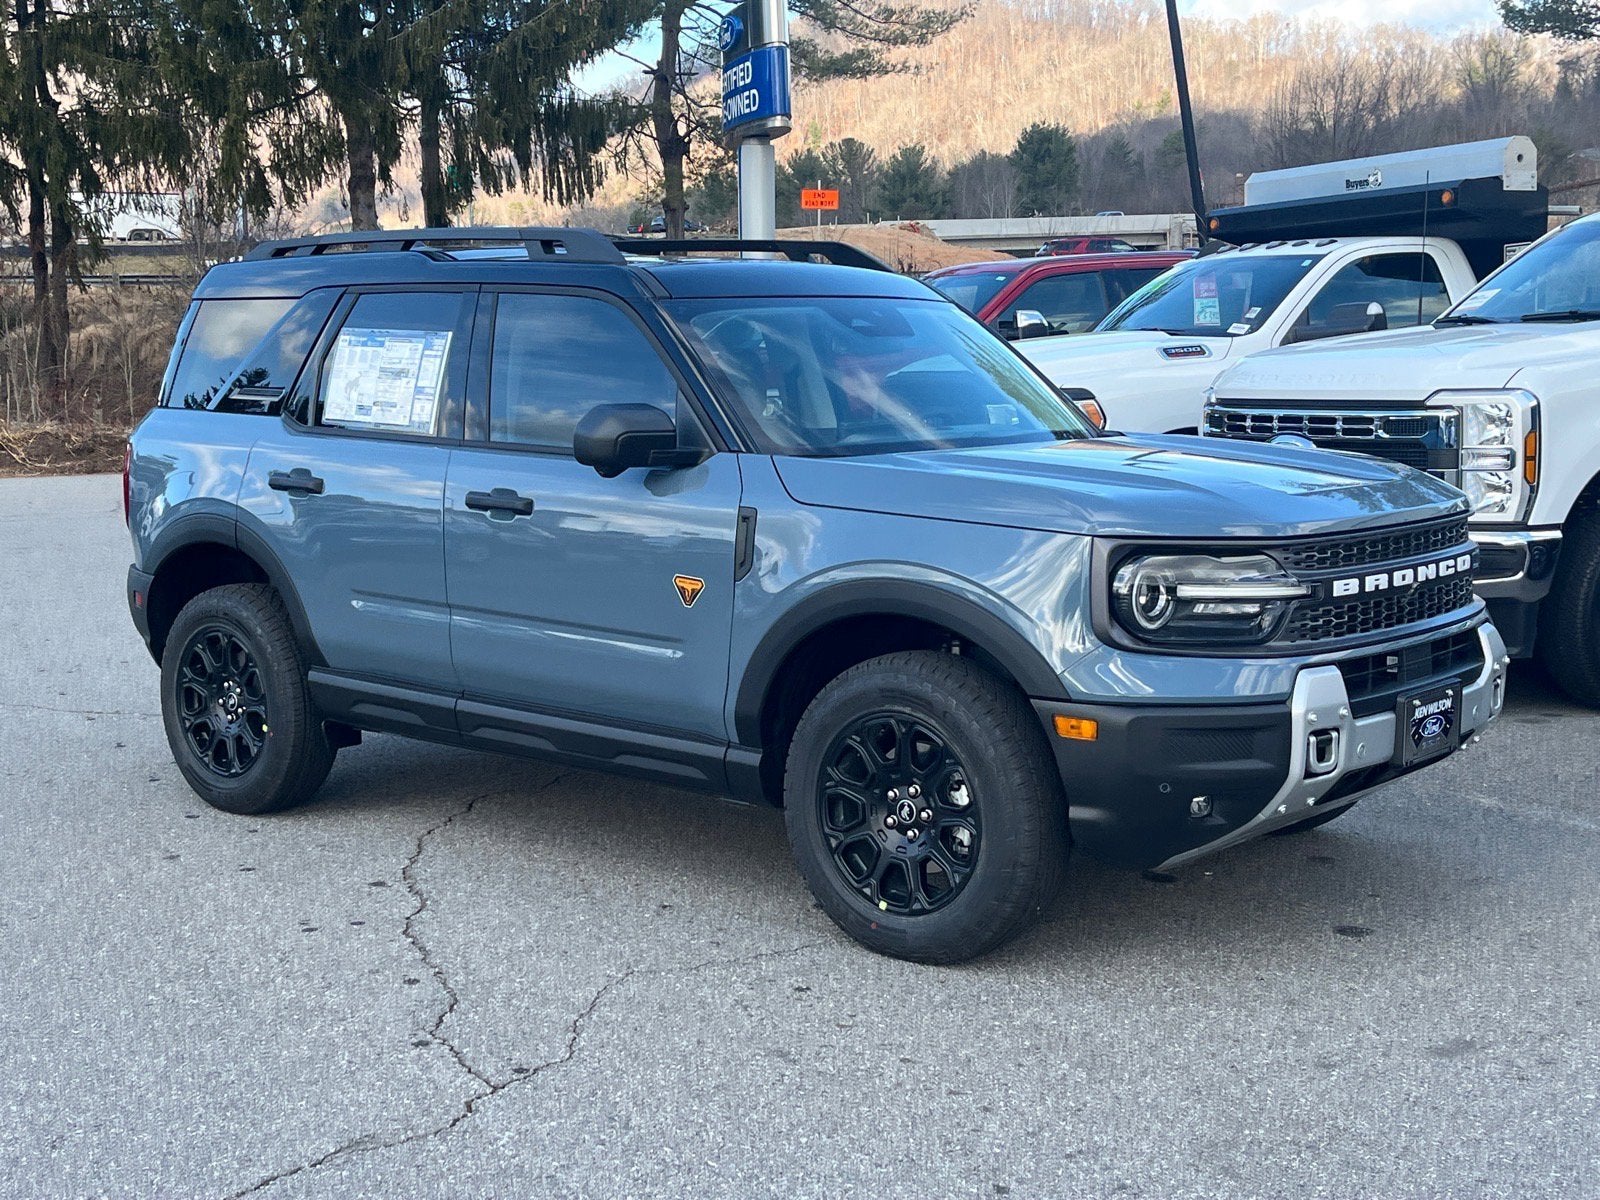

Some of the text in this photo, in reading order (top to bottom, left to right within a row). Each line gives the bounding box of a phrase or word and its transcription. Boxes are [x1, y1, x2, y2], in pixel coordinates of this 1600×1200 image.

[1345, 179, 1370, 189] Buyers
[1164, 346, 1201, 354] 3500
[1332, 554, 1471, 597] BRONCO
[1427, 697, 1452, 715] WILSON
[1424, 718, 1441, 735] Ford
